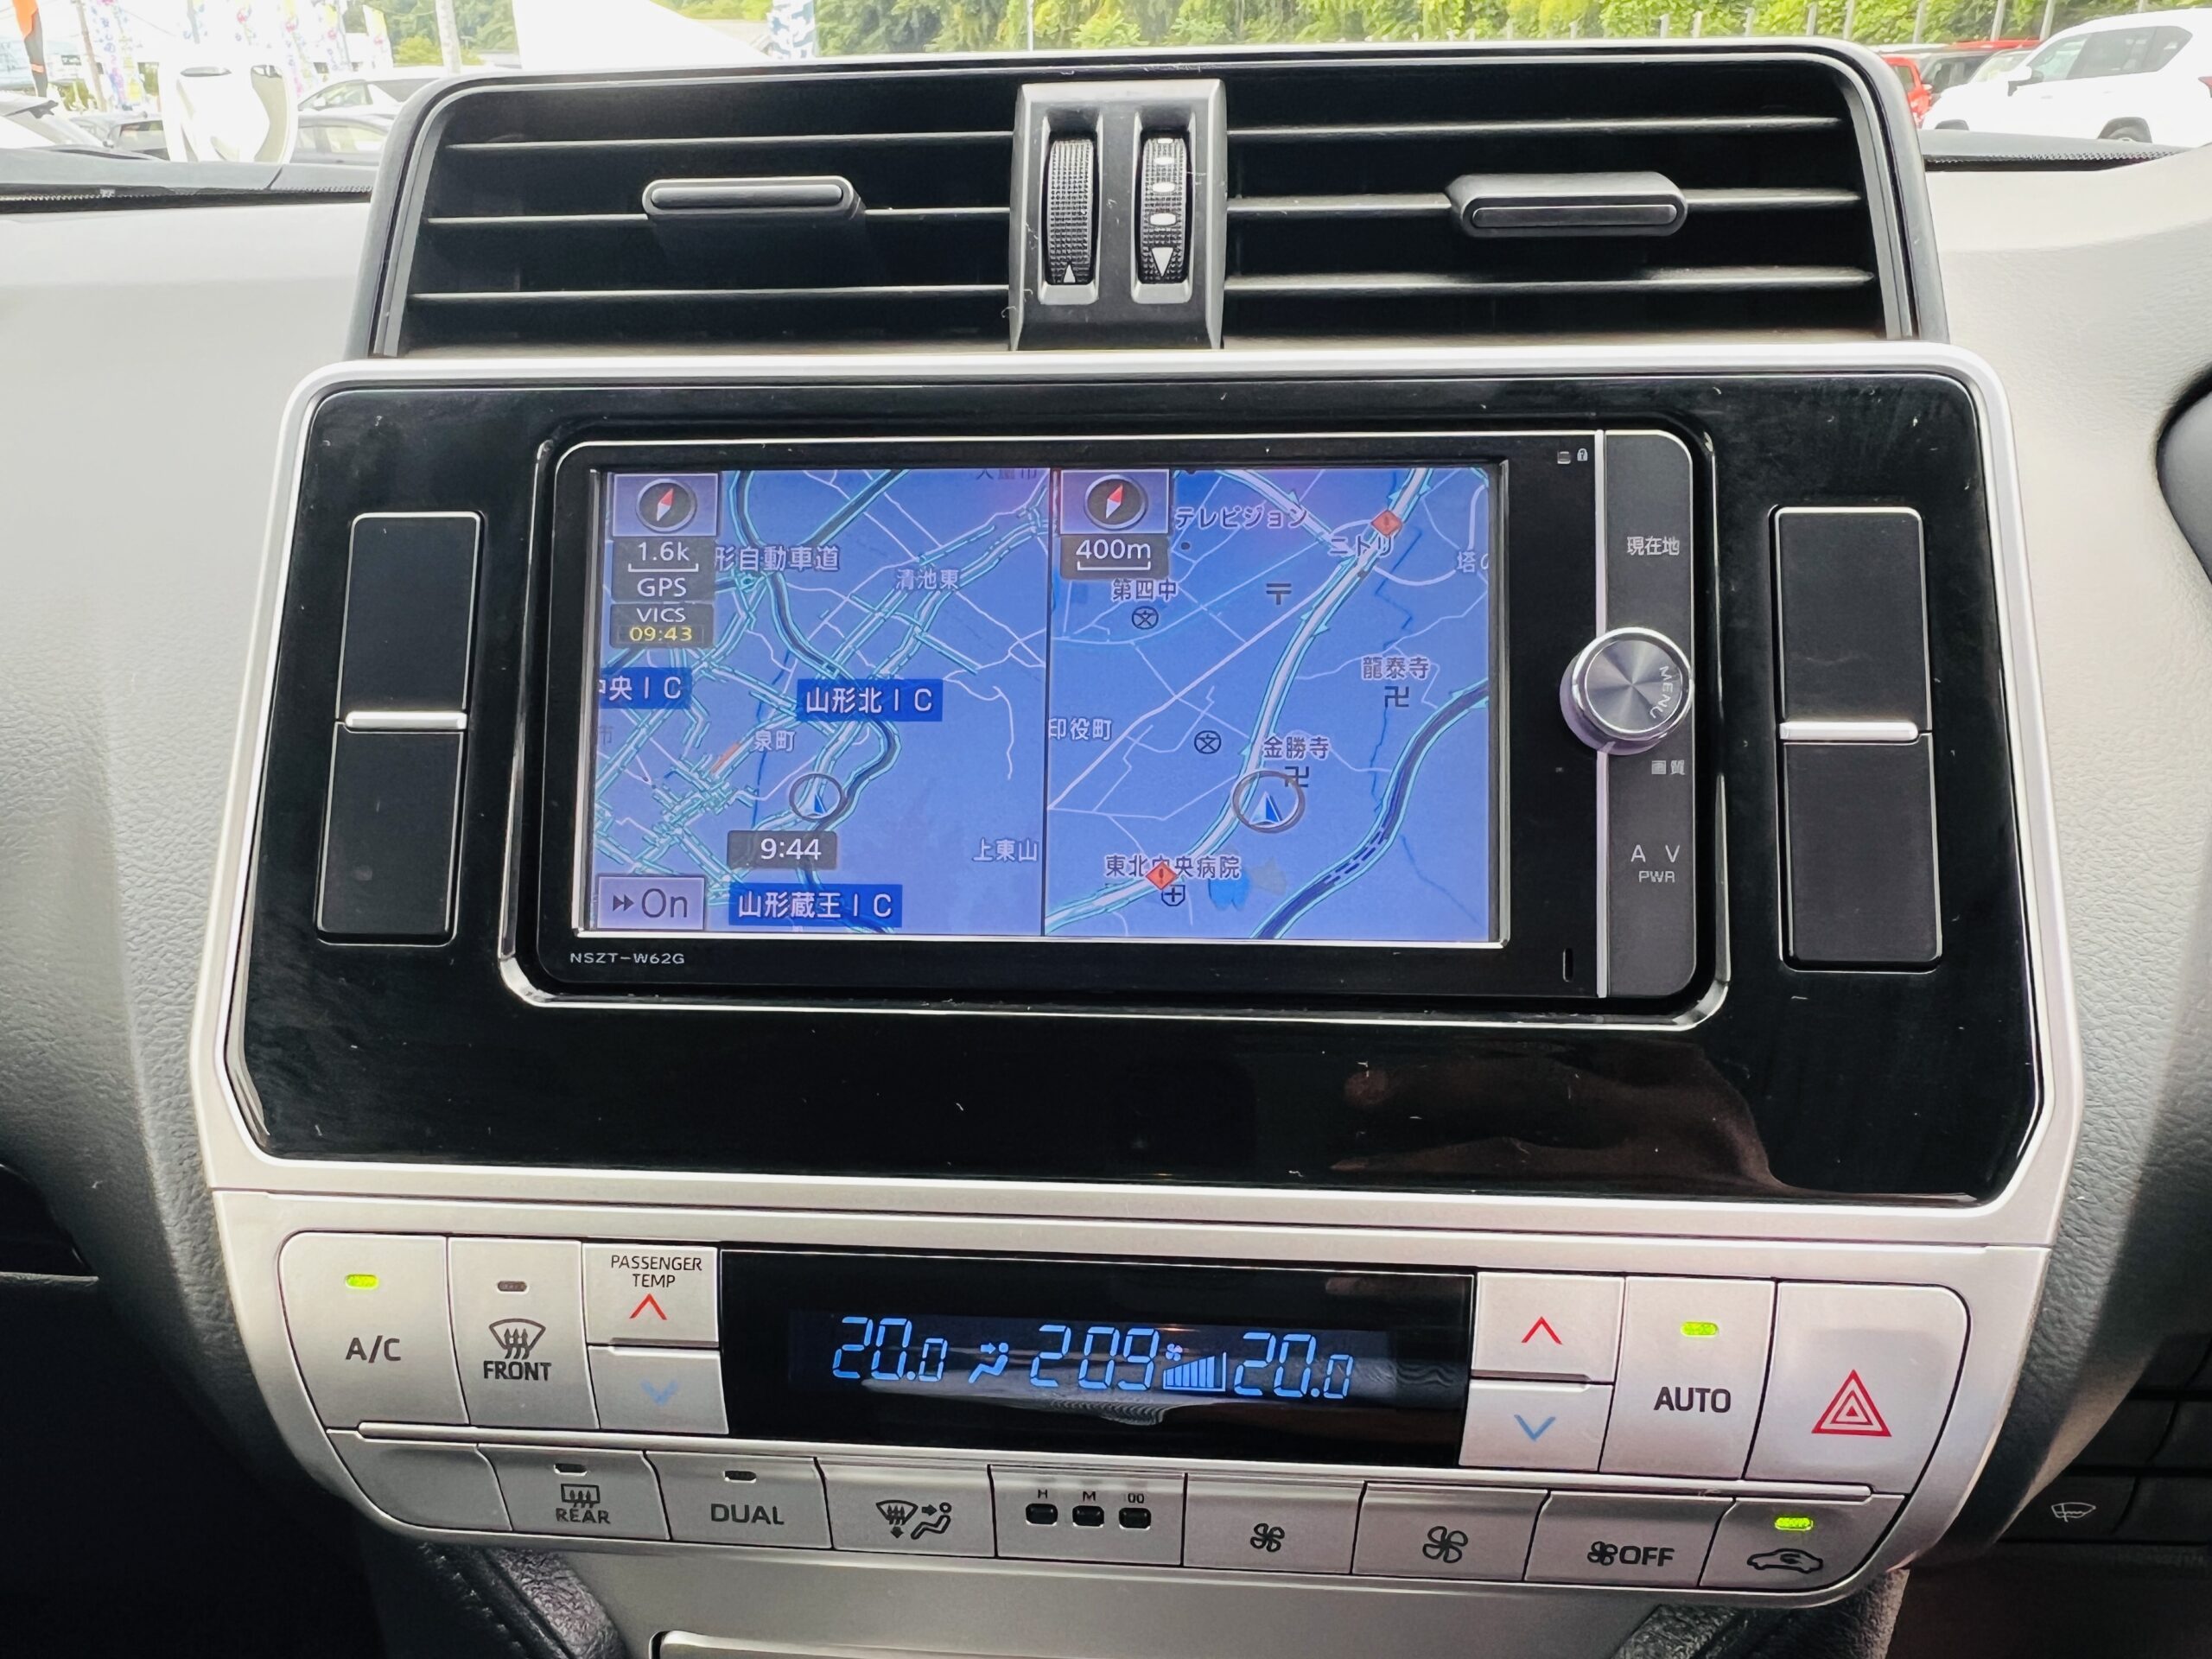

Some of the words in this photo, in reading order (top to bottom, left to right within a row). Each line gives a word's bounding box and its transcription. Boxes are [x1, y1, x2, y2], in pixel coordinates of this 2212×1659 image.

[1174, 506, 1306, 529] テレビジョン
[638, 541, 690, 562] 1.6k
[1076, 539, 1151, 560] 400m
[1330, 536, 1393, 556] ニトリ
[1627, 536, 1680, 556] 現在地
[715, 546, 840, 572] 形自動車道
[637, 577, 687, 597] GPS
[1112, 578, 1177, 601] 第四中
[637, 608, 686, 622] VICS
[629, 627, 691, 641] 09:43
[1363, 657, 1430, 679] 龍泰寺
[1649, 665, 1673, 719] MENU
[1048, 718, 1112, 741] 印役町
[754, 731, 795, 752] 泉町
[1264, 737, 1329, 759] 金勝寺
[760, 839, 822, 860] 9:44
[974, 838, 1038, 862] 上東山
[1106, 855, 1241, 879] 東北央病院
[1639, 870, 1675, 883] PWR
[642, 889, 689, 918] On
[569, 952, 685, 964] NSZT-W62G
[610, 1255, 702, 1271] PASSENGER
[632, 1274, 676, 1288] TEMP
[346, 1336, 401, 1363] A/C
[832, 1316, 947, 1382] 20.0
[1234, 1332, 1353, 1400] 20.0
[483, 1361, 551, 1381] FRONT
[1654, 1387, 1731, 1410] AUTO
[1038, 1490, 1048, 1499] H
[1083, 1491, 1096, 1502] M
[1128, 1493, 1145, 1503] 00
[556, 1508, 610, 1524] REAR
[710, 1503, 785, 1526] DUAL
[1619, 1545, 1674, 1567] OFF
